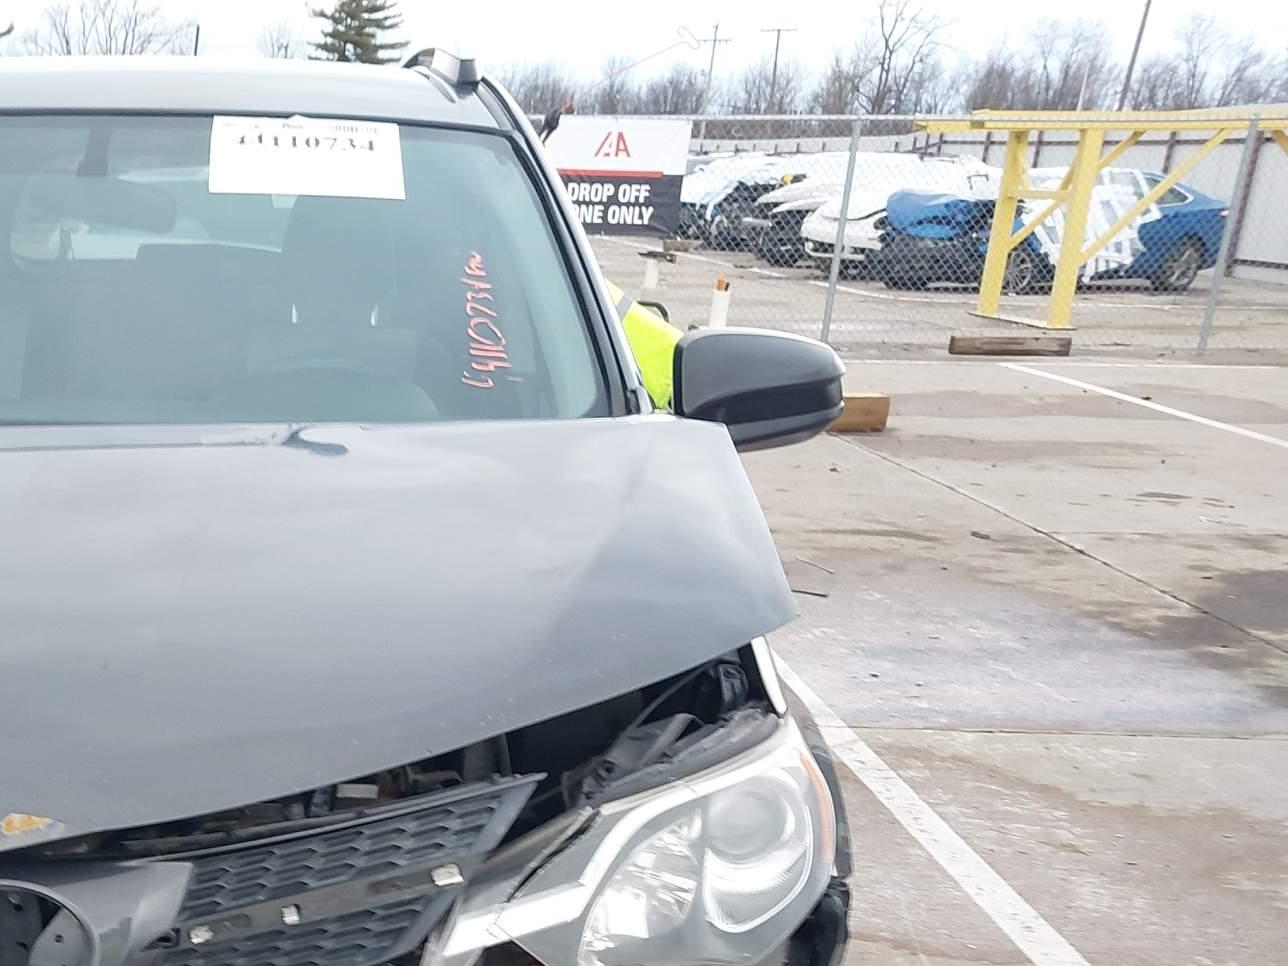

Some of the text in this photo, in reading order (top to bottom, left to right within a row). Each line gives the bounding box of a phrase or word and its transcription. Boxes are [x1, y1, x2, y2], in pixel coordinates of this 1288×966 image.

[567, 182, 651, 204] DROP OFF
[607, 205, 655, 225] ONLY
